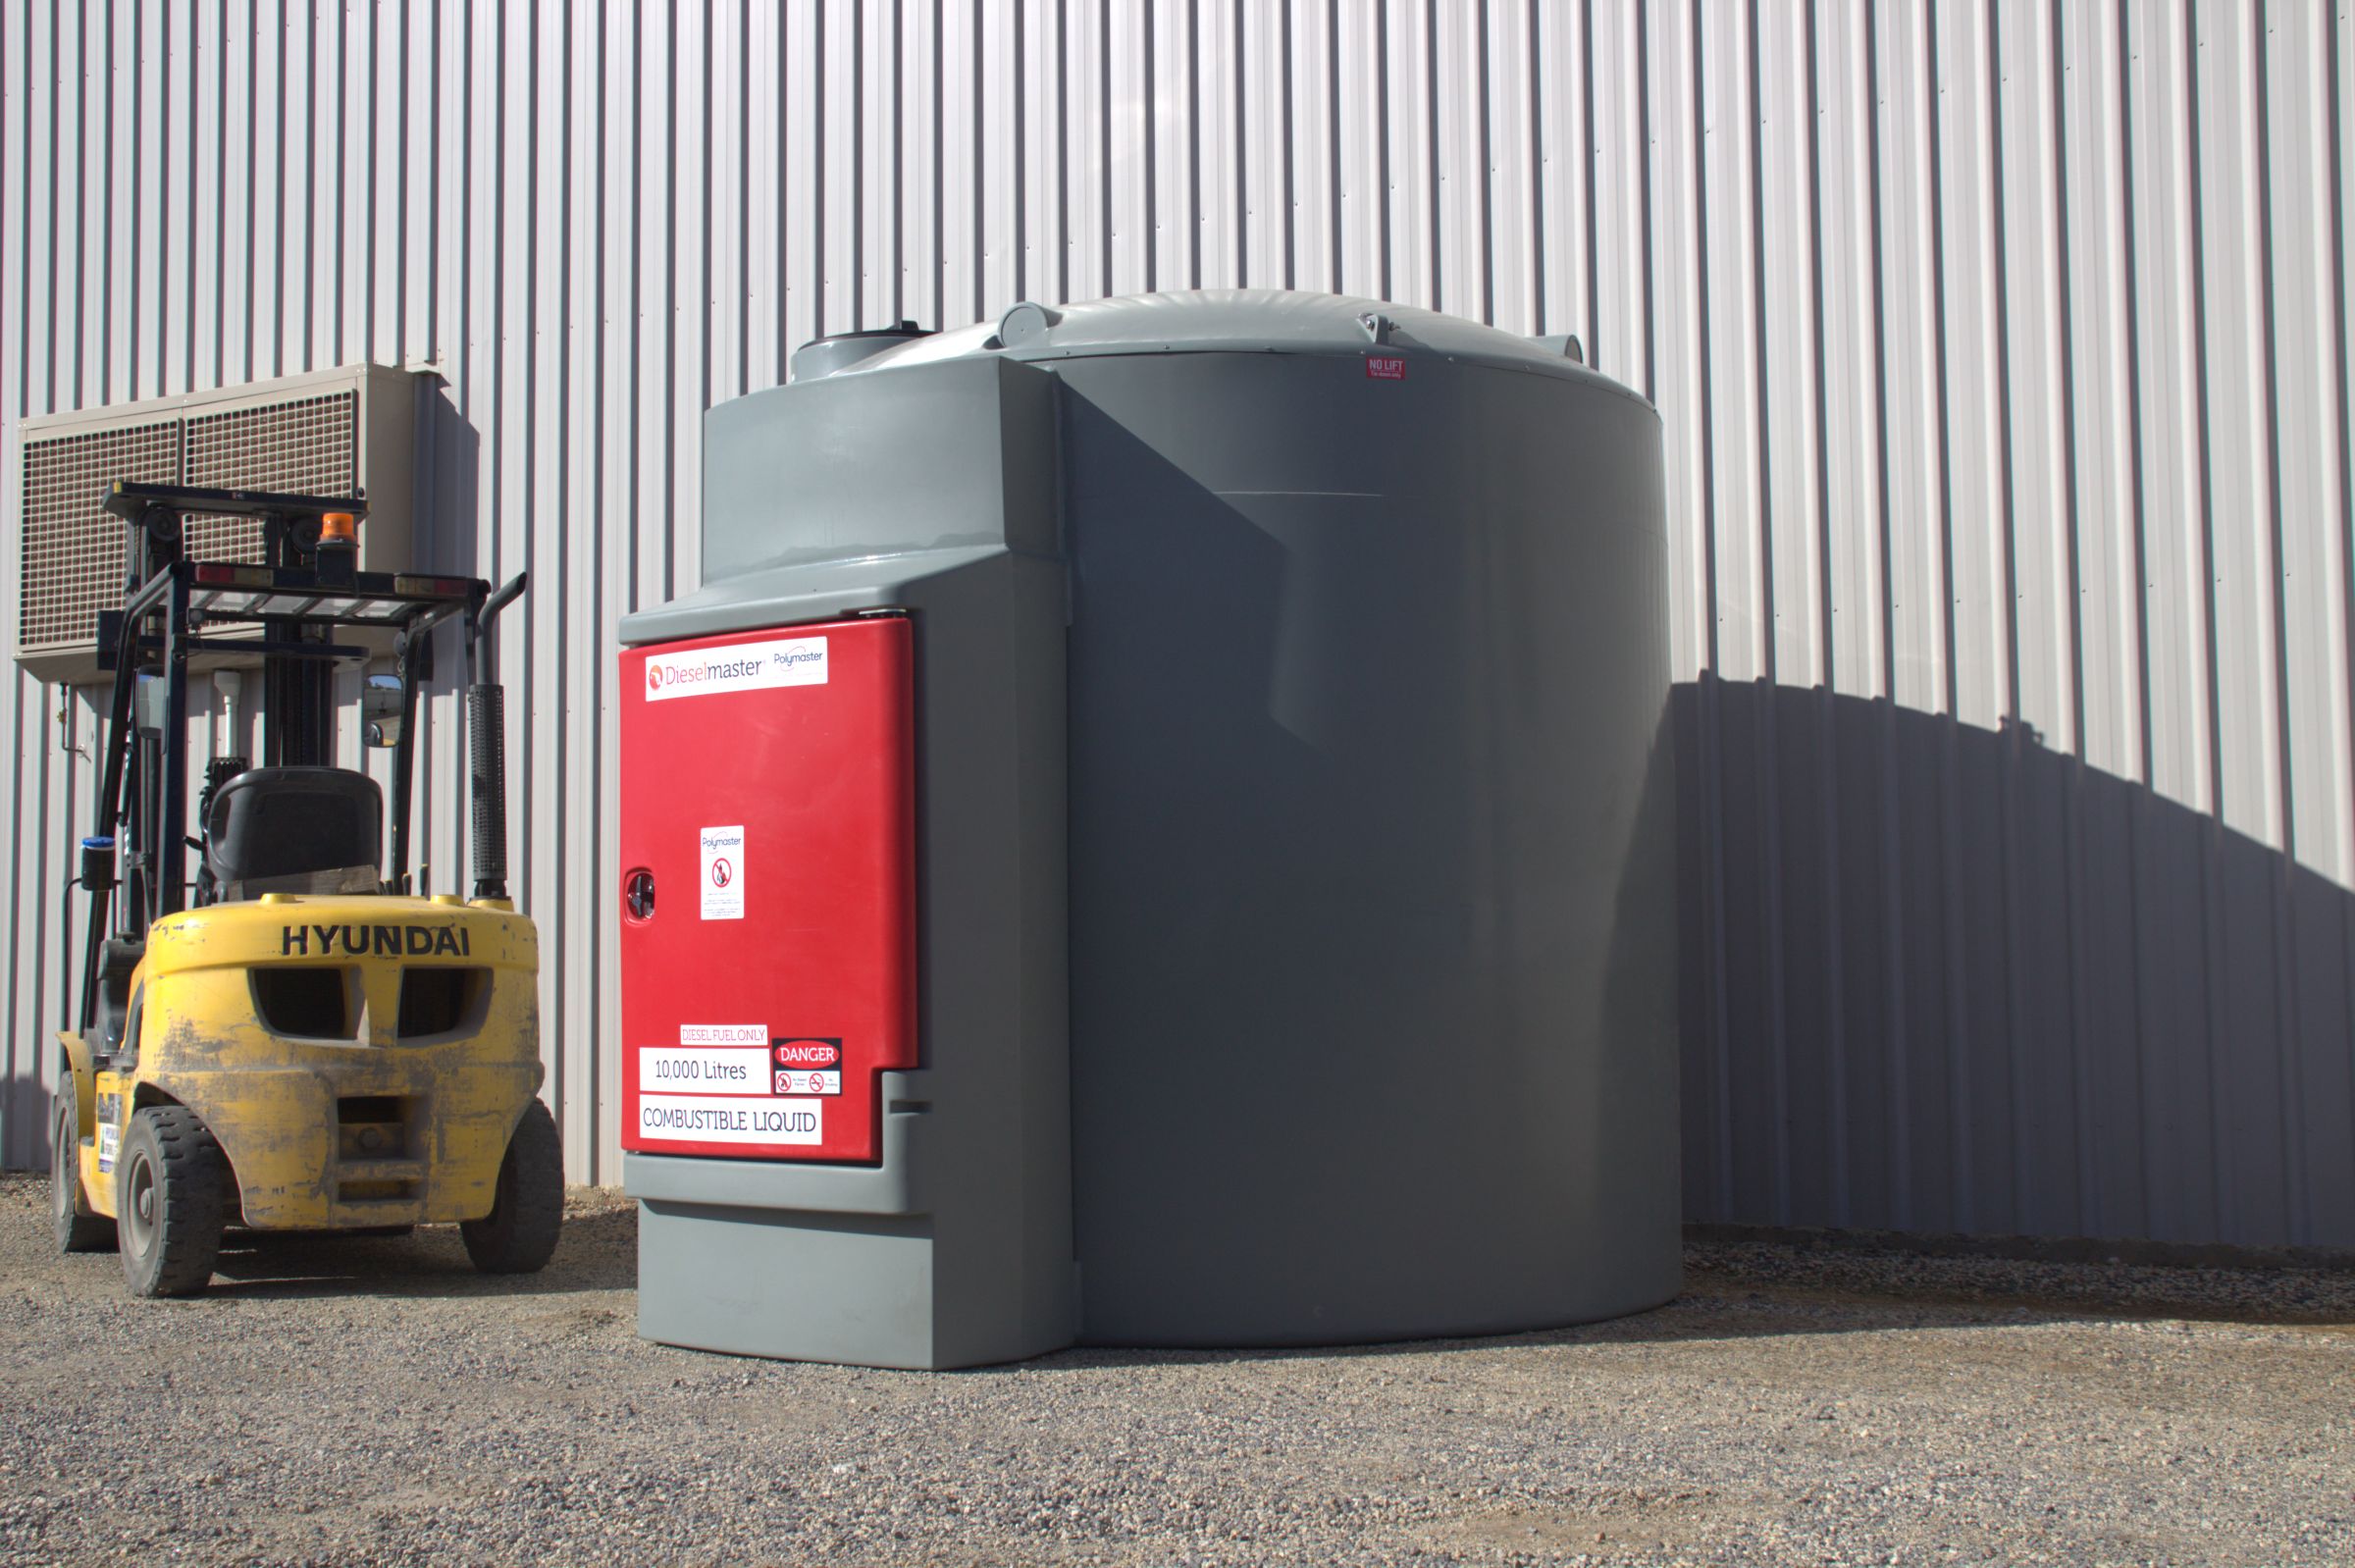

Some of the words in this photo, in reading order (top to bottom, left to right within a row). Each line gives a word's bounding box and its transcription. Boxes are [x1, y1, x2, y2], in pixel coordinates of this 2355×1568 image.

[1369, 359, 1383, 370] NO
[1384, 360, 1403, 371] LIFT
[773, 652, 822, 666] Polymaster
[664, 658, 761, 685] Dieselmaster
[702, 836, 741, 850] Polymaster
[282, 924, 470, 957] HYUNDAI
[682, 1029, 711, 1041] DIESEL
[712, 1029, 736, 1041] FUEL
[737, 1029, 765, 1041] ONLY
[779, 1047, 835, 1062] DANGER
[655, 1060, 699, 1080] 10,000
[704, 1061, 747, 1079] Litres
[643, 1108, 748, 1130] COMBUSTIBLE
[754, 1112, 816, 1132] LIQUID
